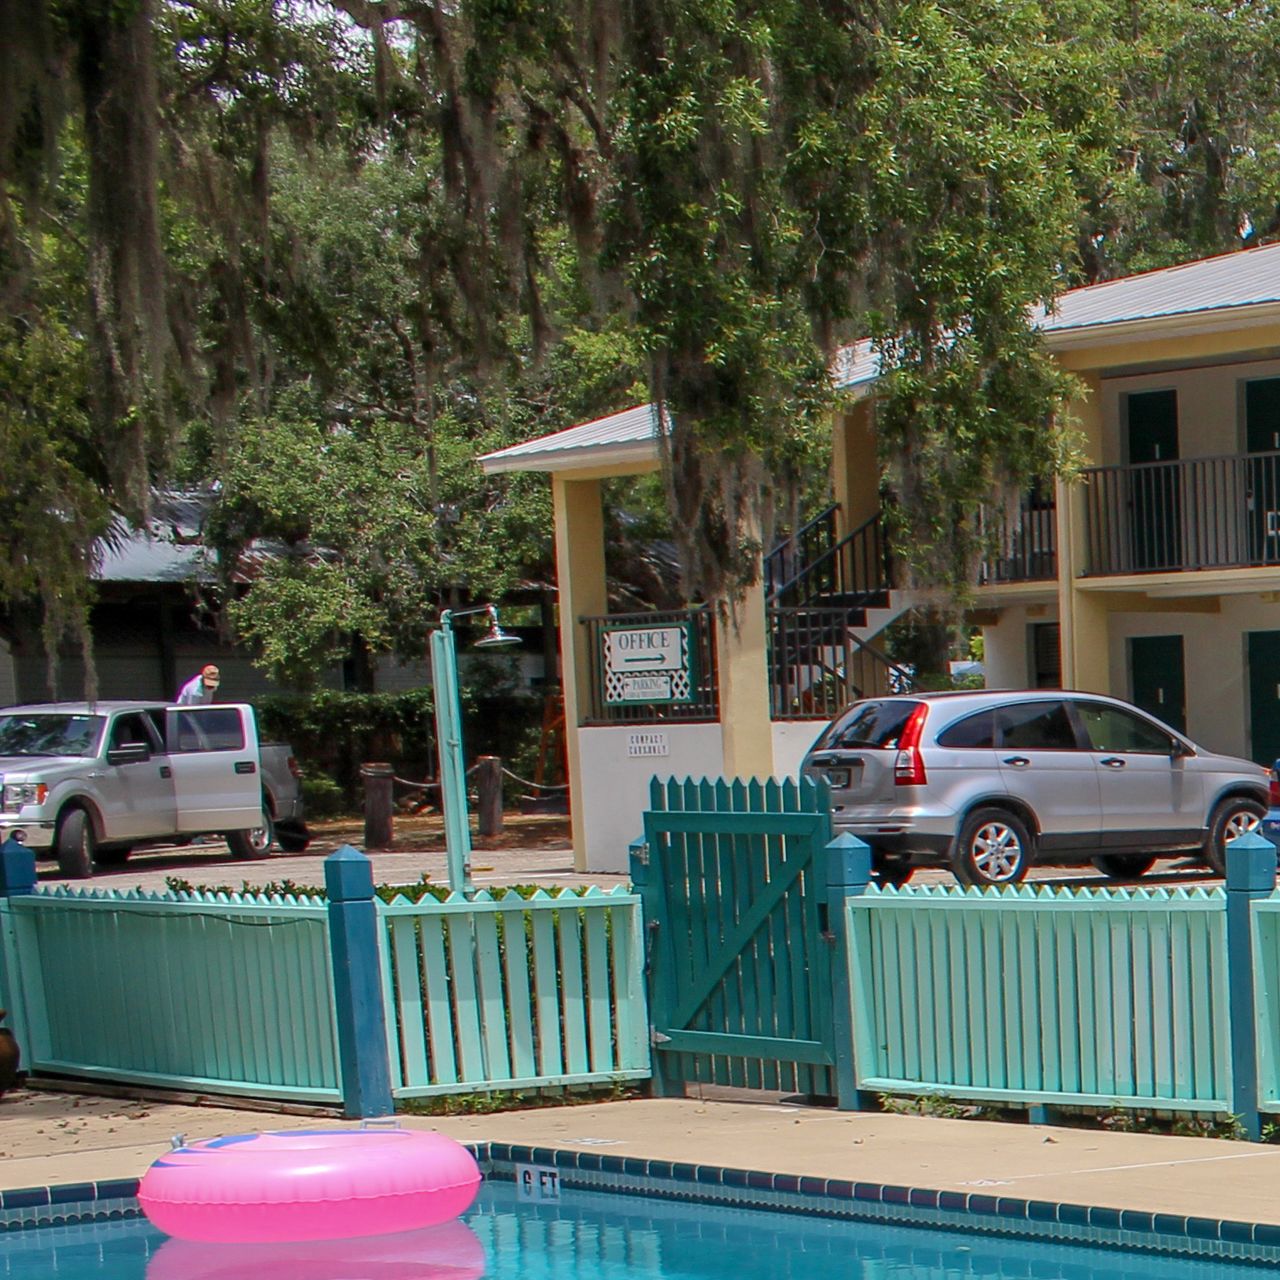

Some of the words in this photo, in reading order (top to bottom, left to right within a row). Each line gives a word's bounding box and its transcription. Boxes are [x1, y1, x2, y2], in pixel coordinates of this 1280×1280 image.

[619, 631, 670, 649] OFFICE
[633, 679, 661, 690] PARKING
[631, 735, 663, 744] COMPACT
